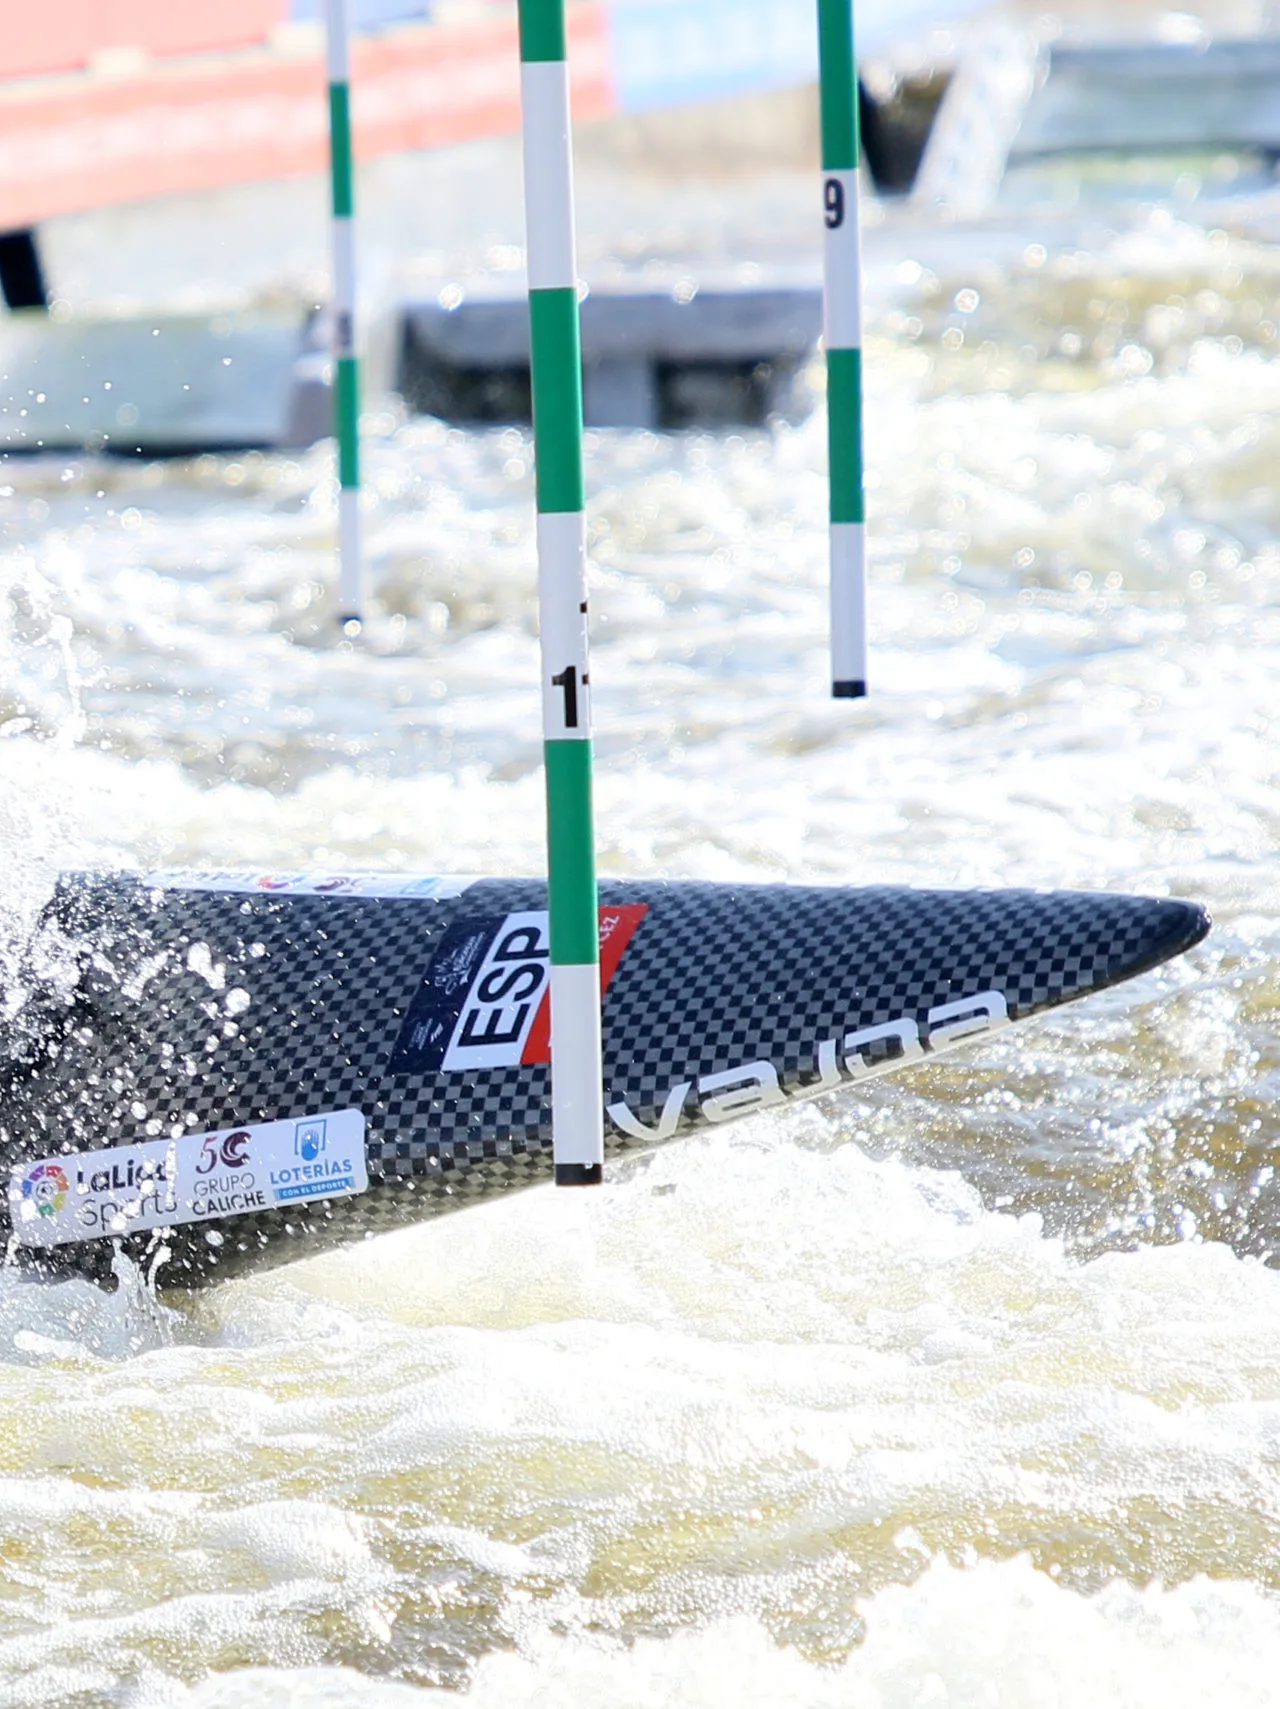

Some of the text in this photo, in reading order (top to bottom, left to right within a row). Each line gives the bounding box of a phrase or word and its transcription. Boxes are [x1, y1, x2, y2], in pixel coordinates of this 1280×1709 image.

[824, 178, 845, 229] 9
[457, 926, 549, 1046] ESP
[607, 990, 1012, 1141] vajda
[192, 1190, 266, 1215] CALICHE
[193, 1172, 255, 1197] GRUPO
